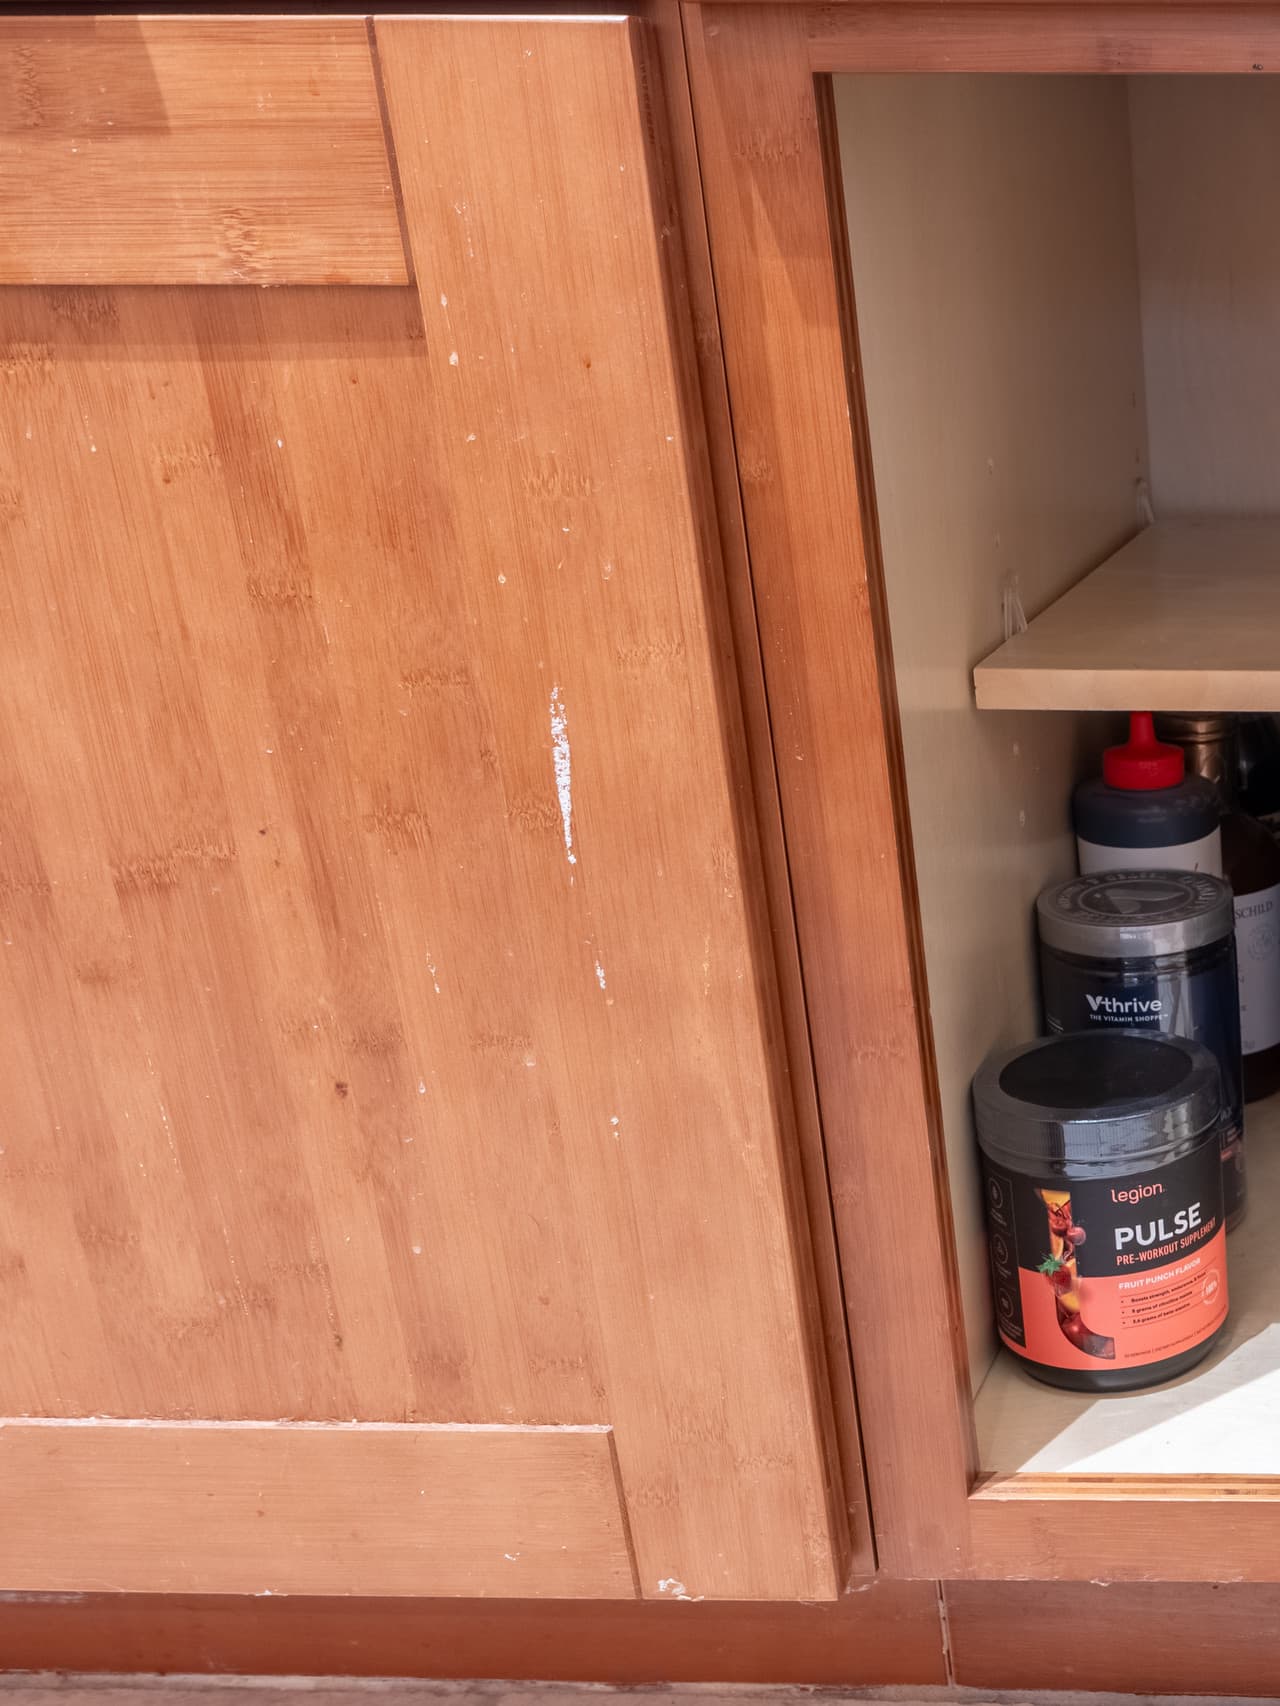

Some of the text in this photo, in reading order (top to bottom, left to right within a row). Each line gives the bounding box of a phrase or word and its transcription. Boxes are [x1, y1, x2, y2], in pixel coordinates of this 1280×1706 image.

[1089, 1014, 1102, 1022] THE
[1103, 1014, 1134, 1022] VITAMIN
[1114, 1202, 1202, 1250] PULSE
[1116, 1216, 1216, 1266] PRE-WORKOUT SUPPLEMENT
[1118, 1257, 1201, 1290] FRUIT PUNCH FLAVOR
